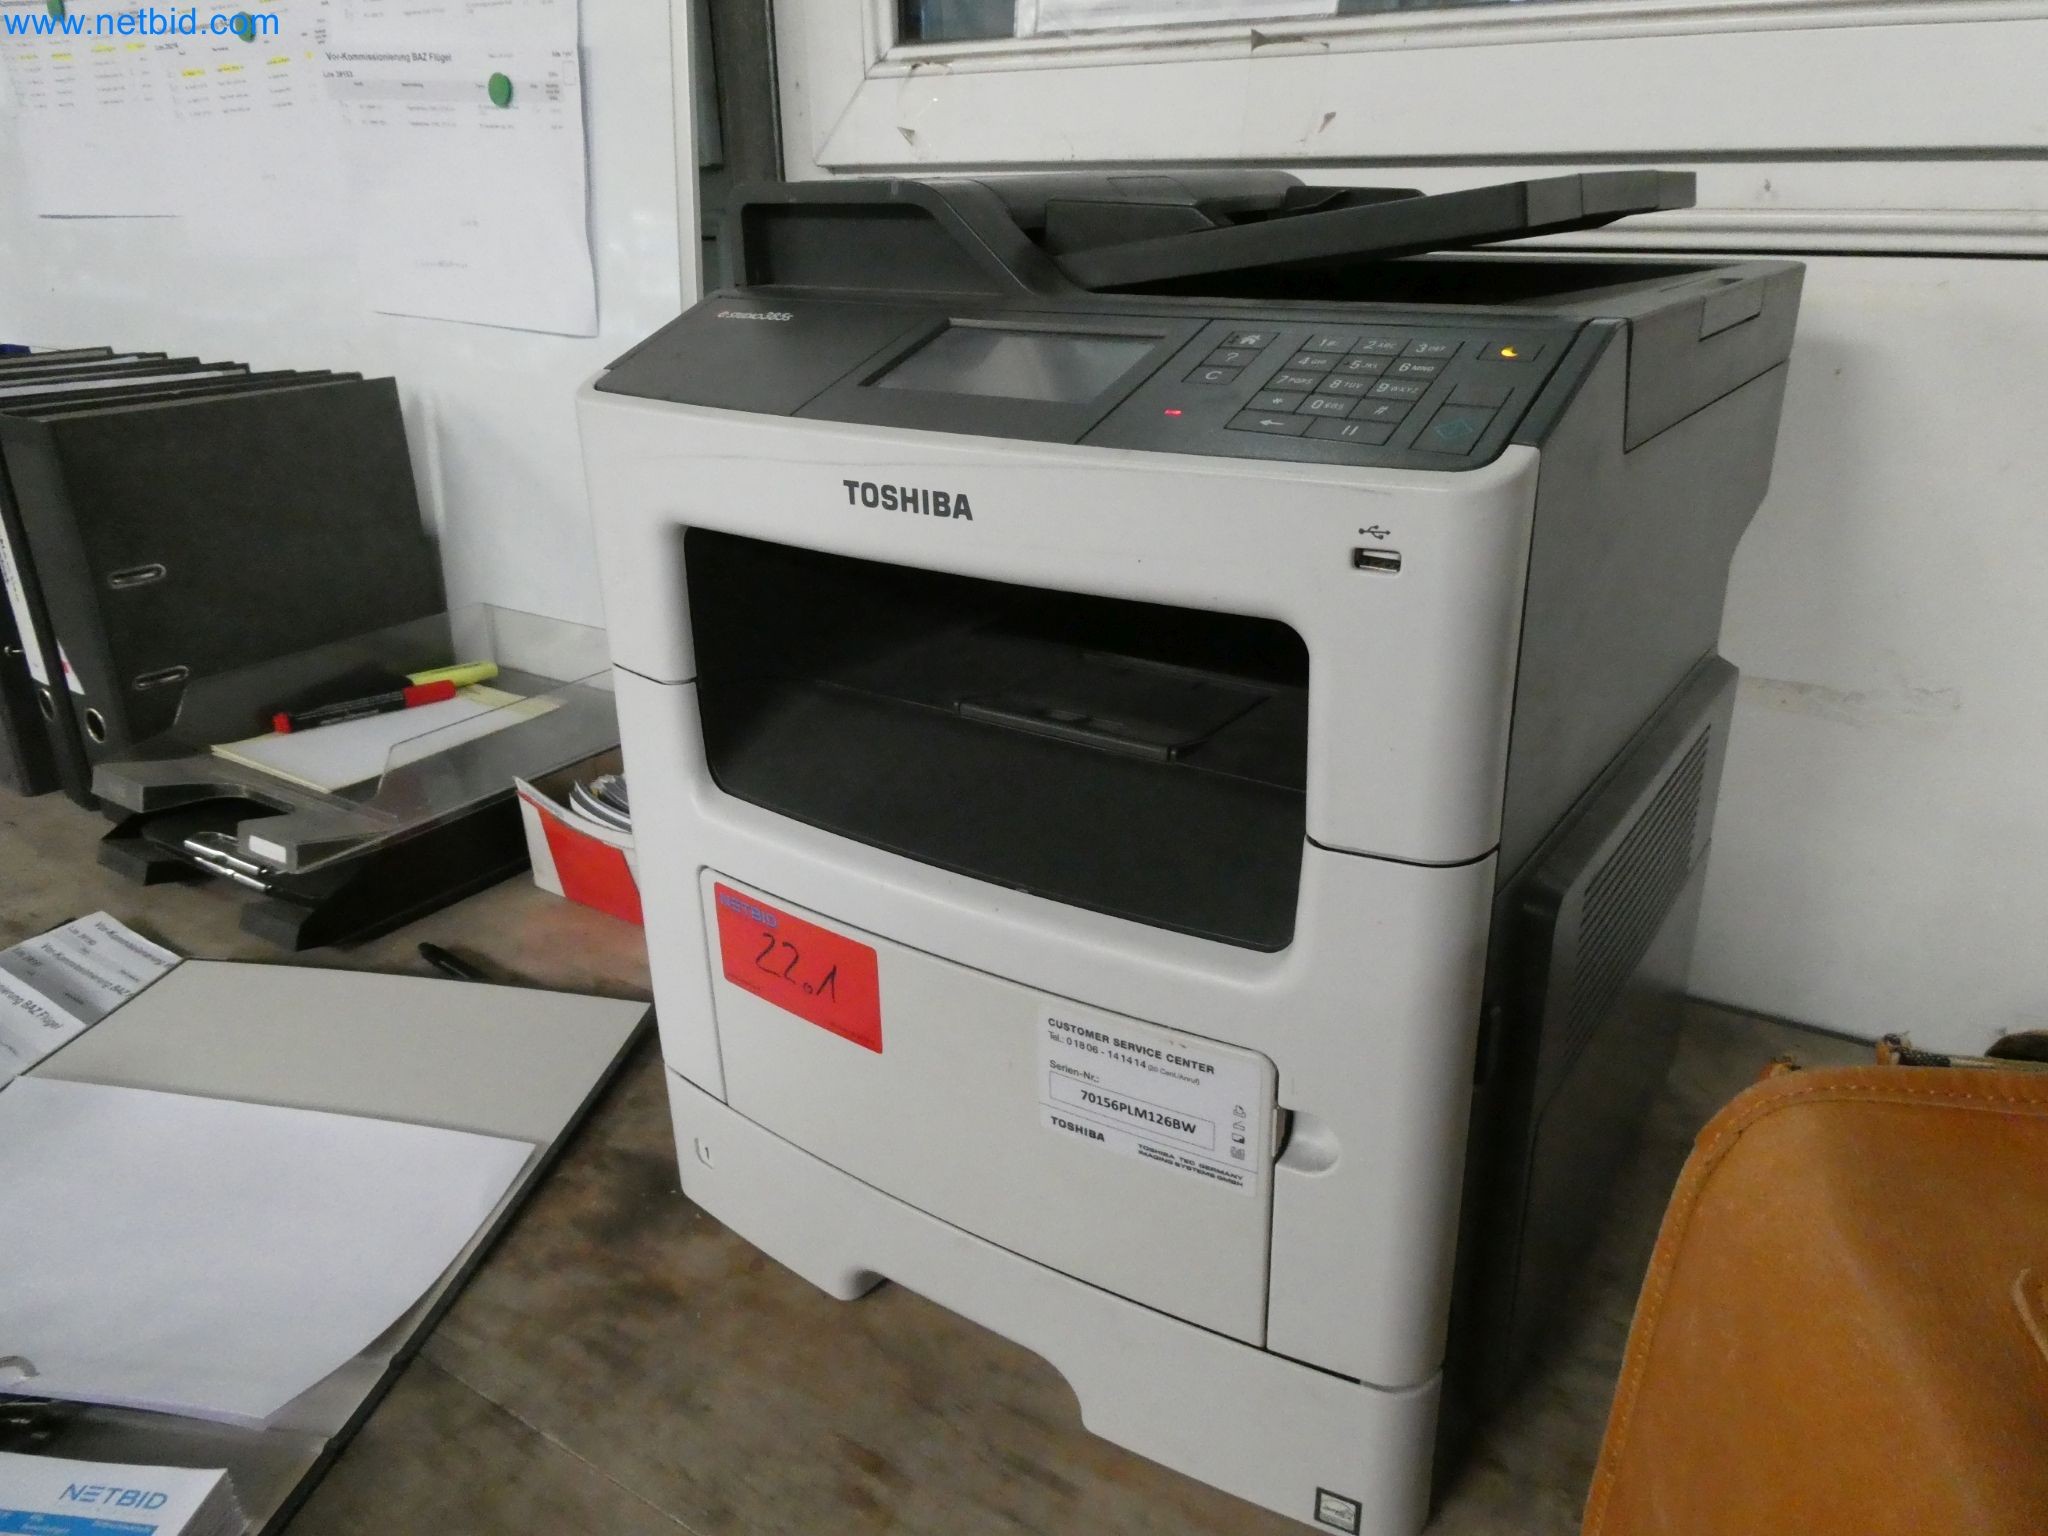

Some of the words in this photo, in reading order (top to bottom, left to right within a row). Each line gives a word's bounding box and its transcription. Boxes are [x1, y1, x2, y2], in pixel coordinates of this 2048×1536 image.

[412, 53, 427, 62] BAZ
[1363, 341, 1377, 350] 2
[1416, 343, 1428, 353] 3
[1349, 360, 1362, 369] 5
[1399, 362, 1411, 372] 6
[1205, 370, 1222, 380] C
[1276, 375, 1289, 384] 7
[1329, 379, 1342, 389] 8
[1377, 382, 1390, 393] 9
[1311, 399, 1324, 409] 0
[843, 480, 973, 521] TOSHIBA
[1048, 1017, 1110, 1044] CUSTOMER
[1113, 1038, 1162, 1060] SERVICE
[1166, 1053, 1215, 1074] CENTER
[1066, 1036, 1099, 1054] 01806
[1080, 1090, 1197, 1134] 70156PLM126BW
[1051, 1116, 1105, 1142] TOSHIBA
[1138, 1143, 1175, 1160] TOSHIBA
[1179, 1156, 1196, 1166] TEC
[1198, 1163, 1243, 1180] GERMANY
[1138, 1150, 1174, 1166] IMAGING
[1174, 1161, 1216, 1178] SYSTEMS
[58, 1484, 168, 1510] NETBID
